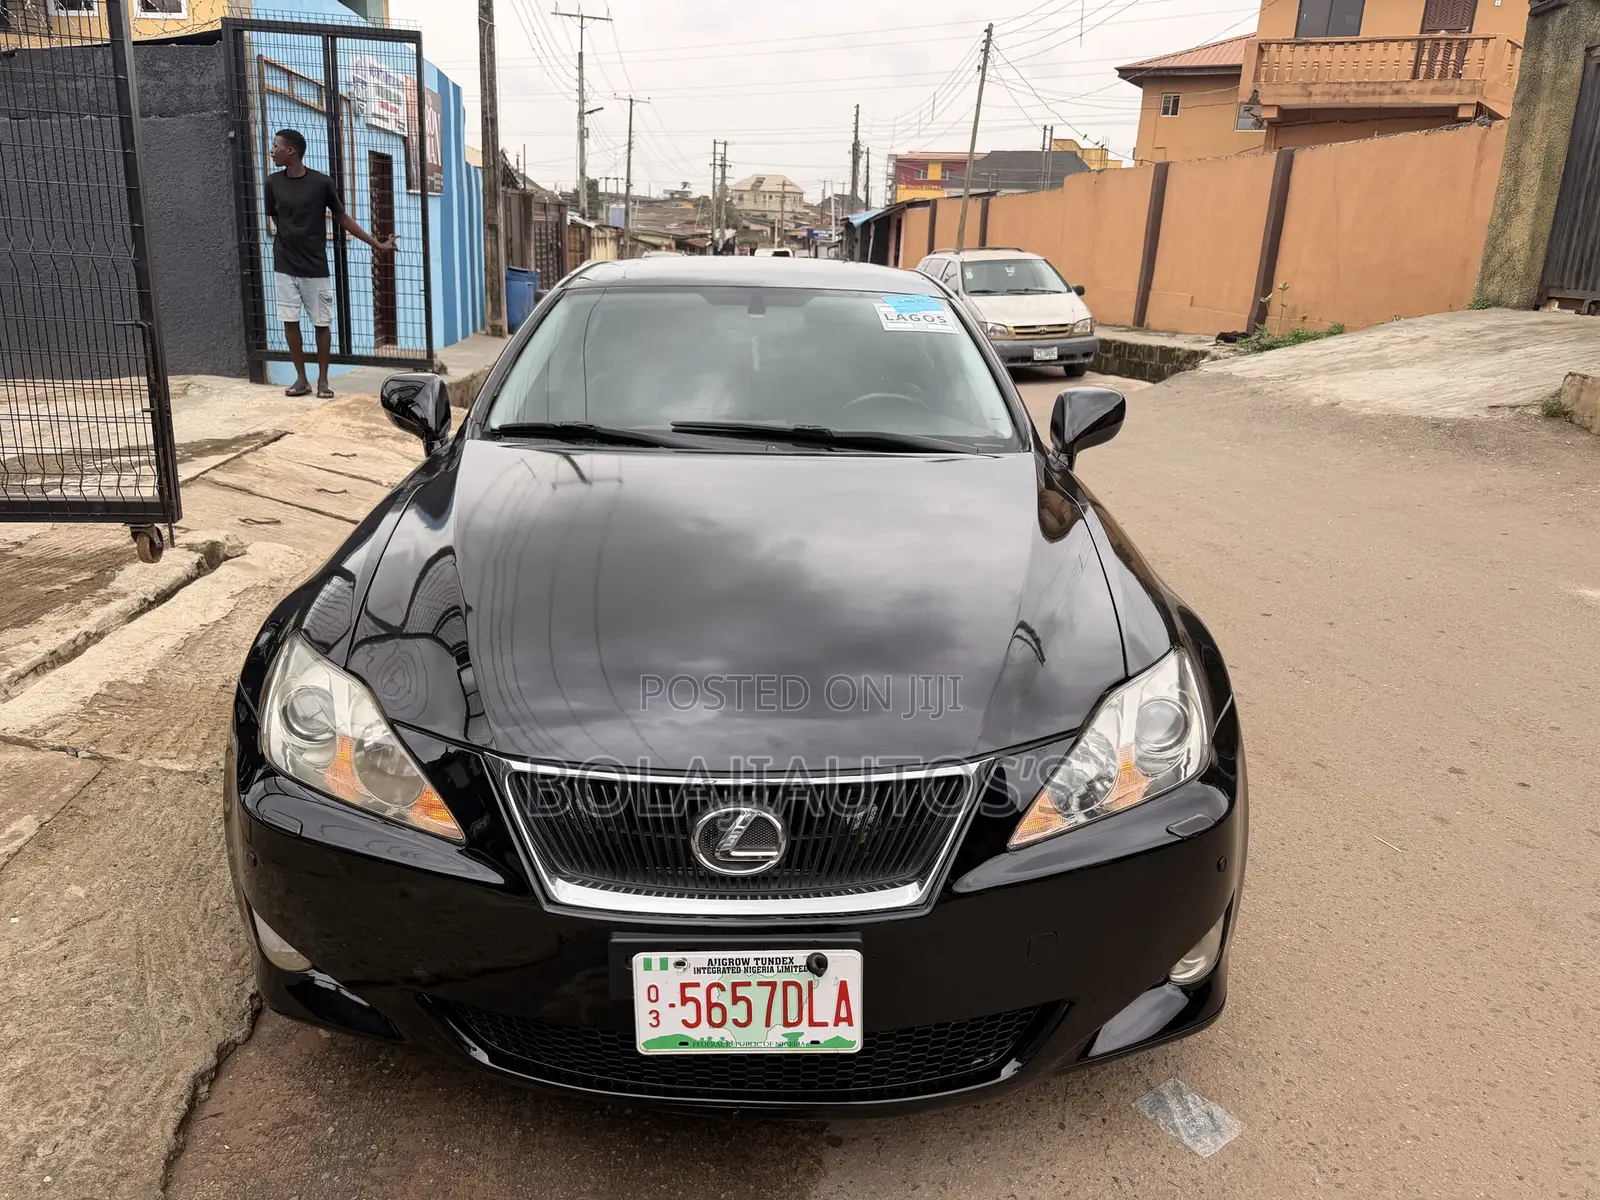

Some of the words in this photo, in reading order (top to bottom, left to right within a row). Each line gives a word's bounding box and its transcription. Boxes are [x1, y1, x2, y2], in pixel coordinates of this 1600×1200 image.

[884, 313, 947, 324] LAGOS
[707, 957, 750, 967] AJIGROW
[754, 956, 794, 966] TUNDEX
[693, 966, 741, 975] INTEGRATED
[743, 966, 775, 974] NIGERIA
[776, 965, 807, 974] LIMITED
[692, 1040, 725, 1048] FEDERAL
[727, 1040, 762, 1048] REPUBLIC
[763, 1040, 774, 1048] OF
[775, 1040, 806, 1048] NIGERIA
